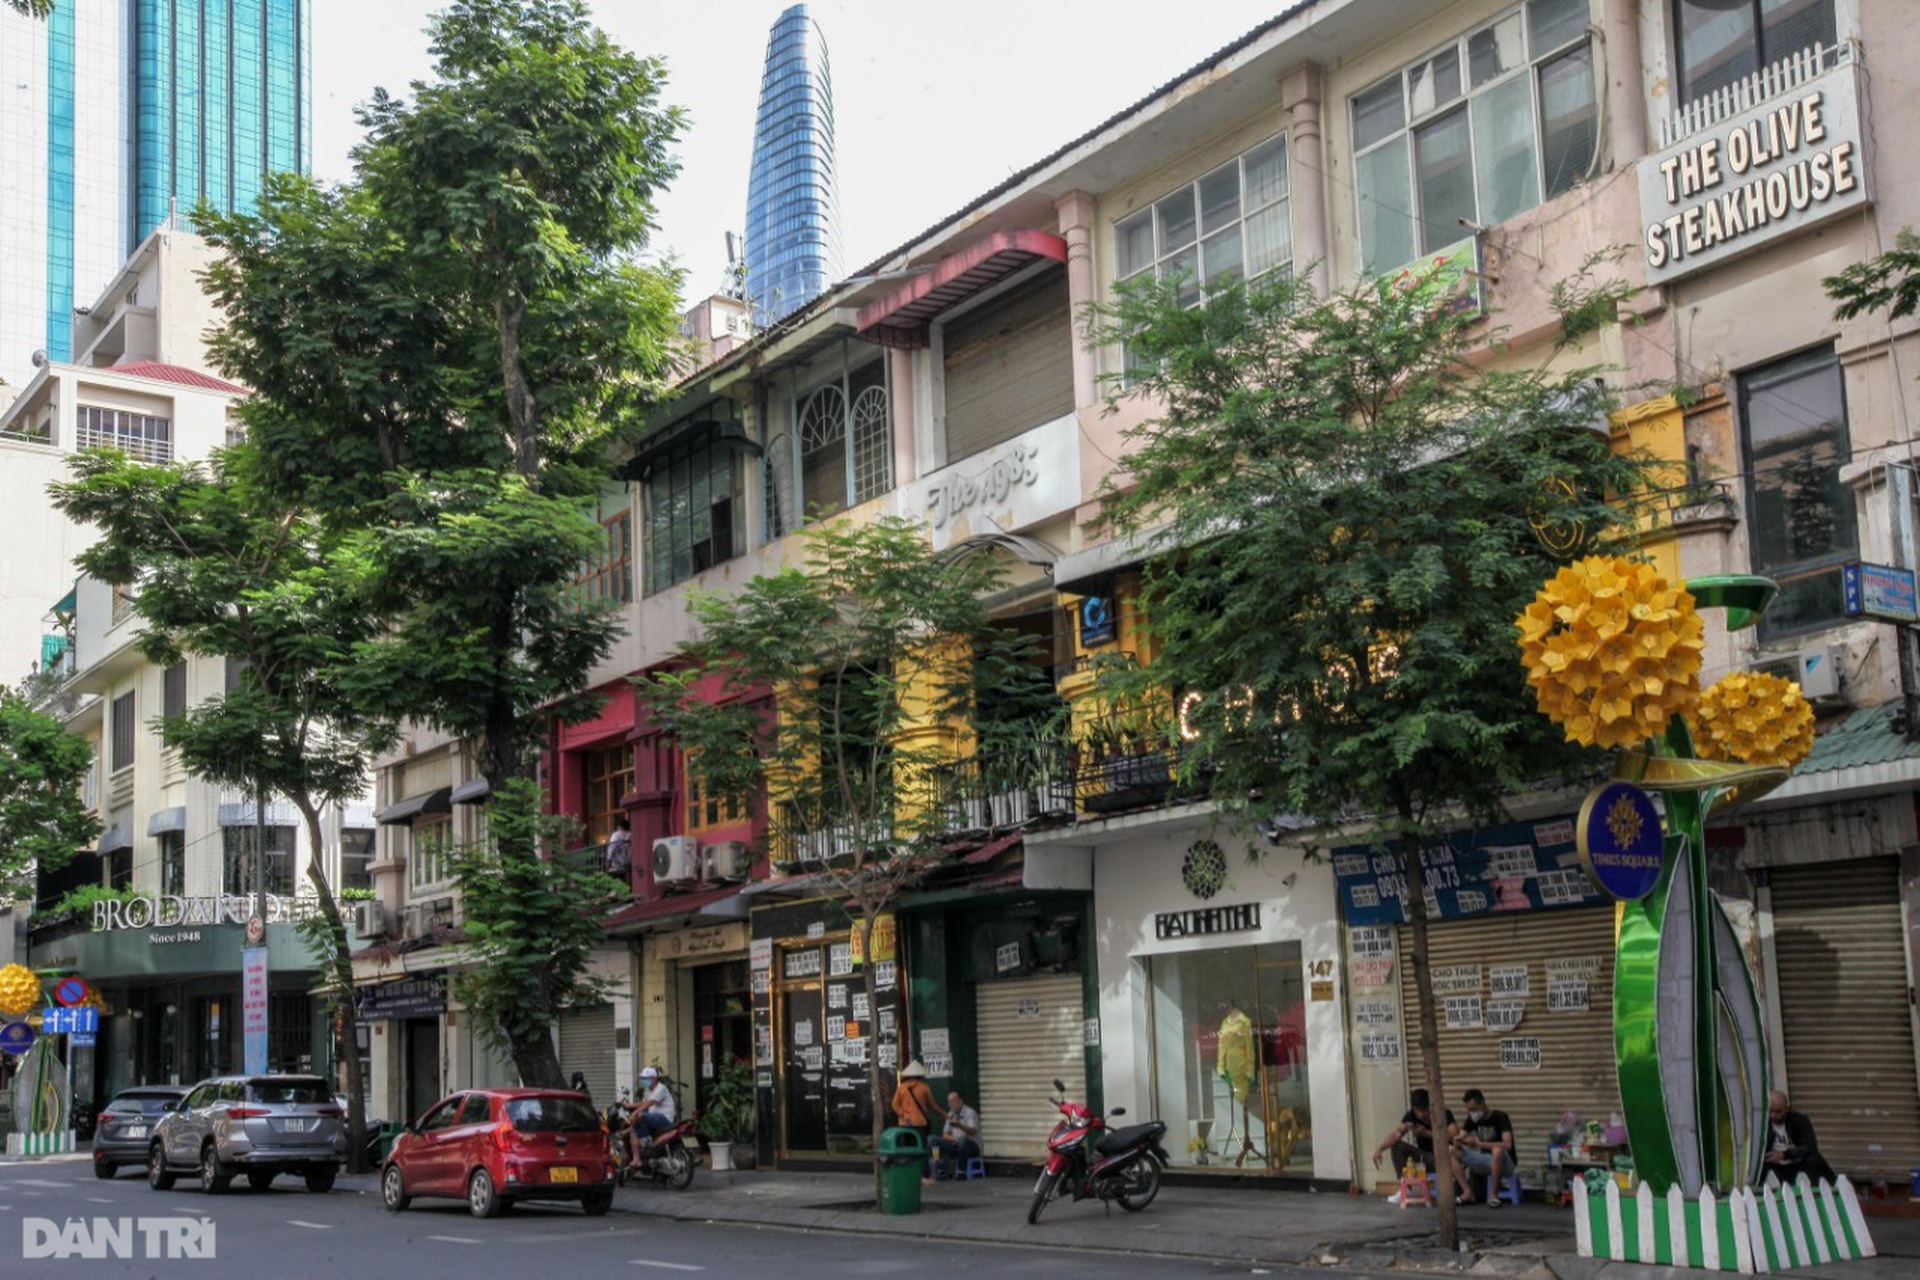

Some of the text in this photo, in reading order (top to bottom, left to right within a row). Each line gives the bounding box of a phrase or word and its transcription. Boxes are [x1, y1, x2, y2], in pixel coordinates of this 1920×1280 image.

[1660, 91, 1826, 204] THE OLIVE
[1647, 141, 1856, 268] STEAKHOUSE
[1592, 853, 1661, 868] TIMES SQUARE
[93, 892, 281, 932] BRODARD
[149, 931, 200, 944] Since 1948
[1308, 961, 1333, 977] 147
